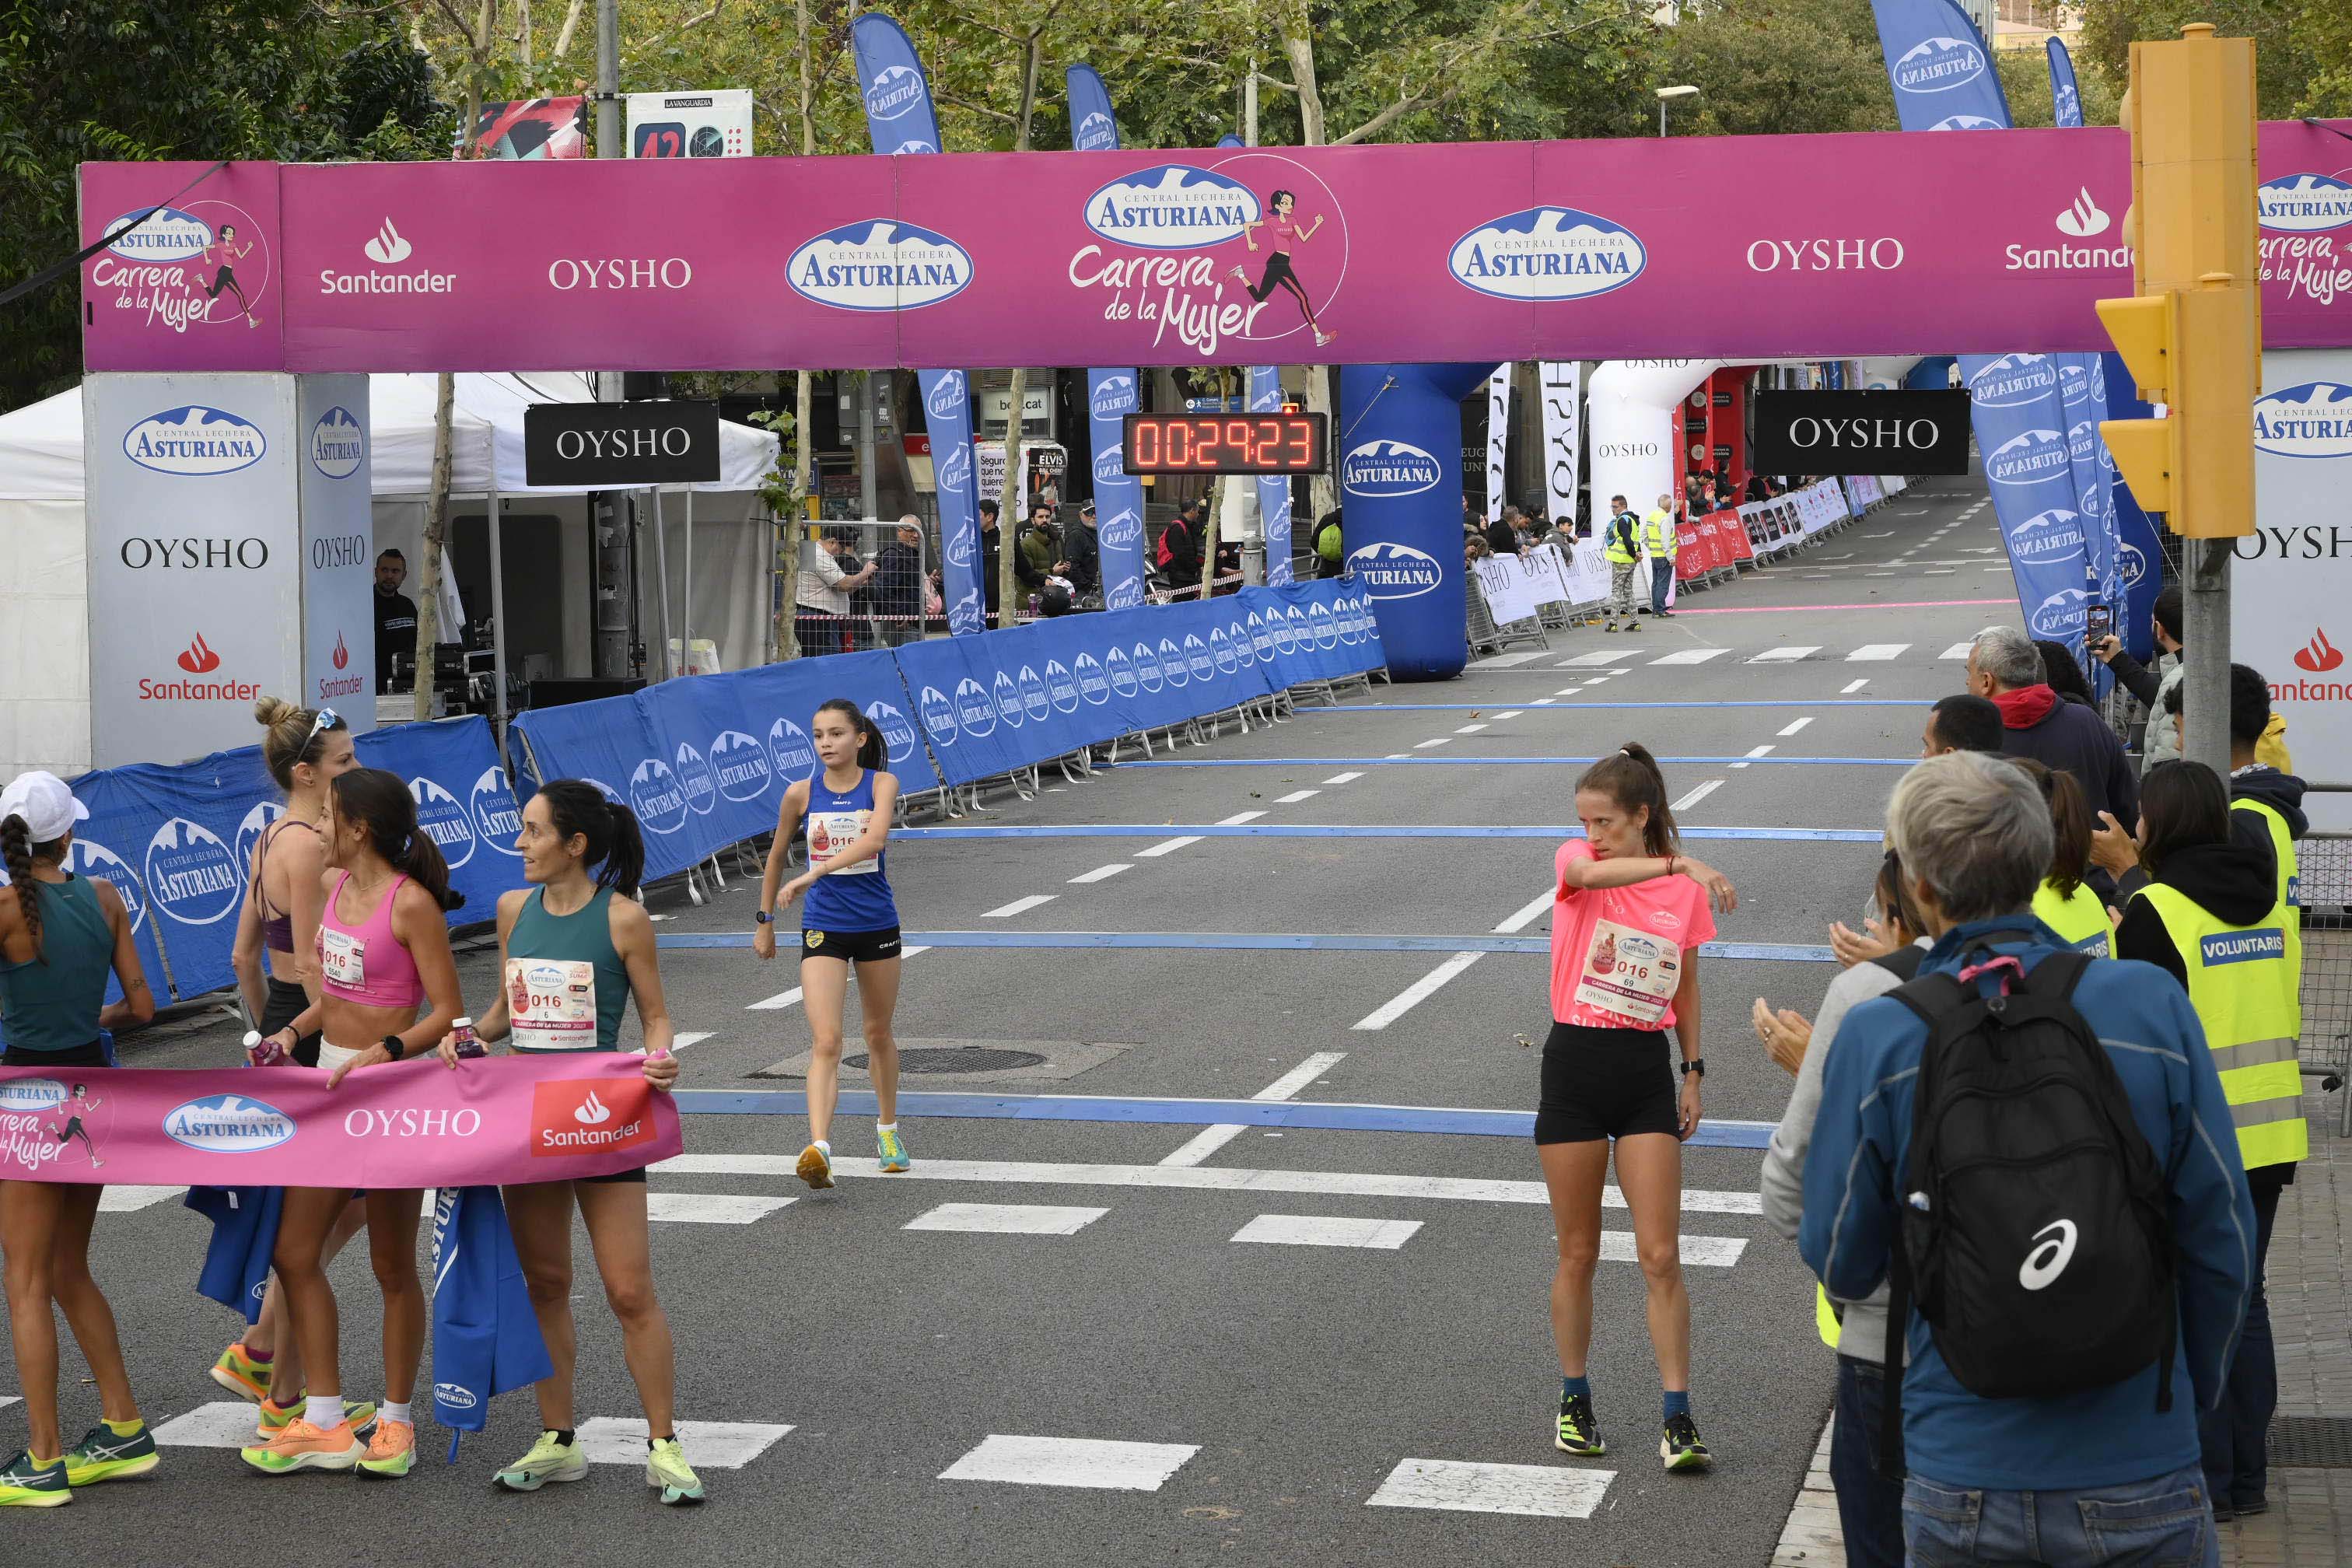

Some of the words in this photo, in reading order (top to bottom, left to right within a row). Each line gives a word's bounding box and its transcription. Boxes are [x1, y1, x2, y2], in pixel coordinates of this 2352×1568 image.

[1124, 193, 1181, 203] CENTRAL
[1185, 192, 1242, 202] LECHERA
[1097, 196, 1246, 228] ASTURIANA
[828, 250, 888, 260] CENTRAL
[894, 250, 954, 260] LECHERA
[1494, 239, 1555, 250] CENTRAL
[1562, 237, 1625, 248] LECHERA
[1747, 237, 1904, 272] OYSHO
[2005, 243, 2135, 270] Santand
[2259, 236, 2333, 258] arrera
[93, 257, 184, 288] Carrera
[800, 254, 960, 288] ASTURIANA
[1069, 244, 1213, 289] Carrera
[1463, 243, 1631, 278] ASTURIANA
[320, 268, 457, 295] Santander
[548, 257, 692, 291] OYSHO
[2277, 260, 2291, 281] la
[2287, 254, 2352, 306] Muje
[116, 288, 133, 309] de
[136, 288, 149, 309] la
[146, 285, 219, 333] Mujer
[1104, 290, 1132, 320] de
[1137, 290, 1157, 320] la
[1152, 282, 1269, 356] Mujer
[1790, 417, 1940, 450] OYSHO
[2253, 411, 2352, 439] ASTURIA
[134, 432, 257, 458] ASTURIANA
[315, 434, 361, 460] ASTURIANA
[556, 427, 691, 460] OYSHO
[1136, 422, 1311, 466] 00:29:23
[1598, 442, 1657, 458] OYSHO
[981, 468, 993, 477] que
[1039, 454, 1063, 465] ELVIS
[982, 477, 1006, 488] quiere
[1346, 464, 1434, 485] ASTURIANA
[121, 537, 268, 569] OYSHO
[313, 534, 365, 569] OYSHO
[2232, 525, 2352, 560] OYSH
[1363, 569, 1434, 586] TURIANA
[138, 678, 261, 700] Santander
[320, 674, 362, 700] Santander
[2267, 678, 2352, 701] antan
[772, 745, 814, 771] ASTURIANA
[713, 758, 769, 788] ASTURIANA
[416, 810, 434, 821] ENTRAL
[485, 797, 511, 809] CENTRAL
[418, 818, 472, 846] TURIANA
[478, 803, 523, 837] ASTUR
[831, 837, 855, 846] 016
[163, 854, 194, 869] CENTRAL
[194, 849, 224, 863] LECHERA
[155, 862, 236, 905] ASTURIANA
[326, 950, 346, 968] 016
[1622, 941, 1655, 957] ASTURIANA
[2203, 938, 2283, 959] VOLUNTARIS
[328, 967, 341, 978] 5540
[530, 974, 562, 984] ASTURIANA
[1617, 961, 1649, 979] 016
[1623, 978, 1634, 987] 69
[1591, 979, 1616, 992] CARRERA
[531, 994, 562, 1008] 016
[173, 1114, 286, 1138] ASTURIANA
[344, 1108, 481, 1137] OYSHO
[543, 1120, 642, 1147] Santander
[4, 1131, 69, 1171] Mujer
[436, 1388, 473, 1405] ASTURIANA
